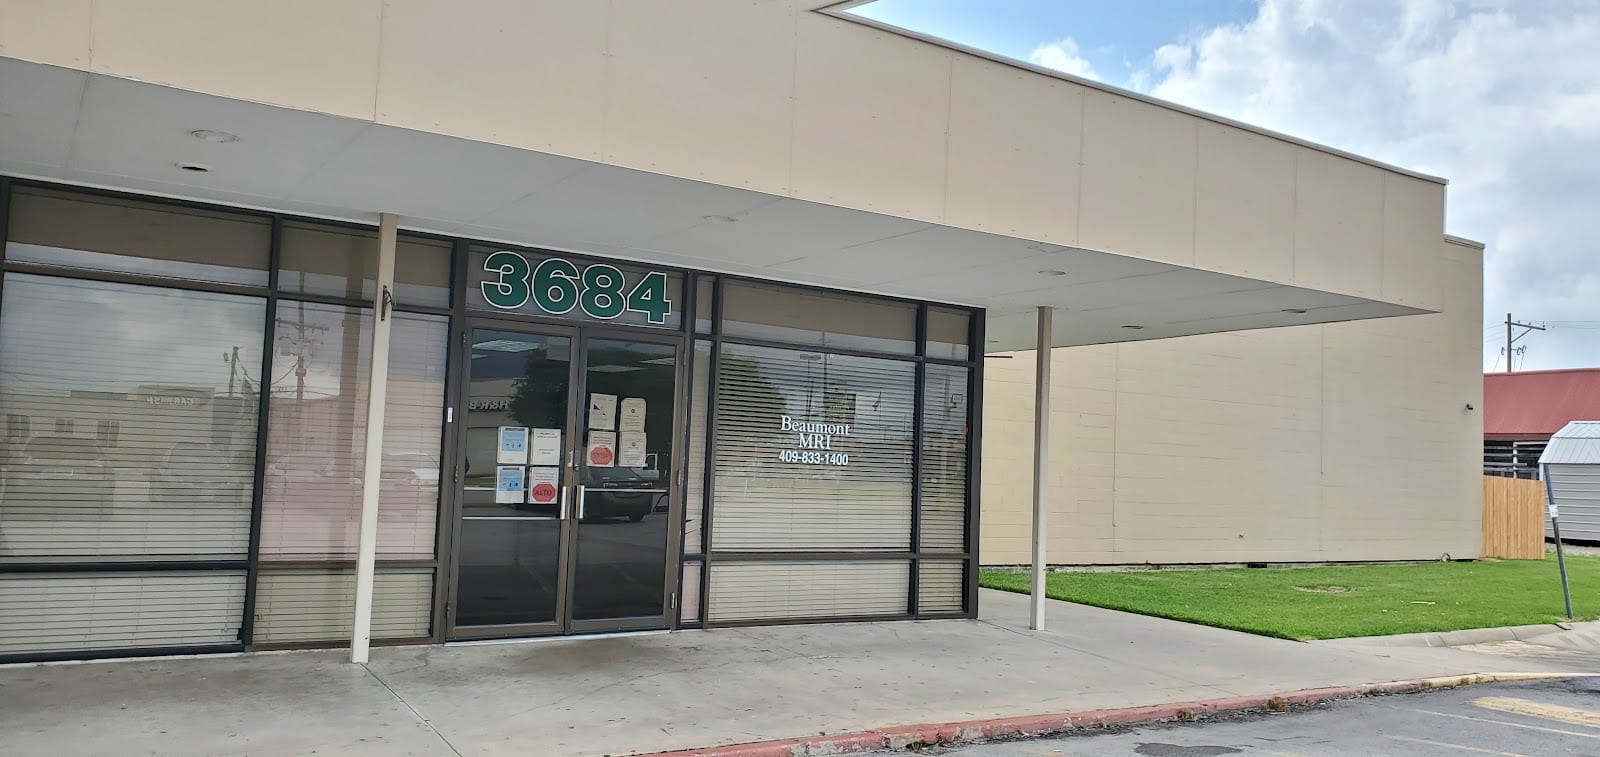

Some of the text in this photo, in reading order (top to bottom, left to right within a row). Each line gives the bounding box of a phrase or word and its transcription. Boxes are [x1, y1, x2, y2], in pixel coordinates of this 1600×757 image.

[481, 251, 671, 324] 3684
[781, 415, 850, 435] Beaumont
[799, 433, 831, 449] MRI
[779, 450, 849, 465] 409-833-1400
